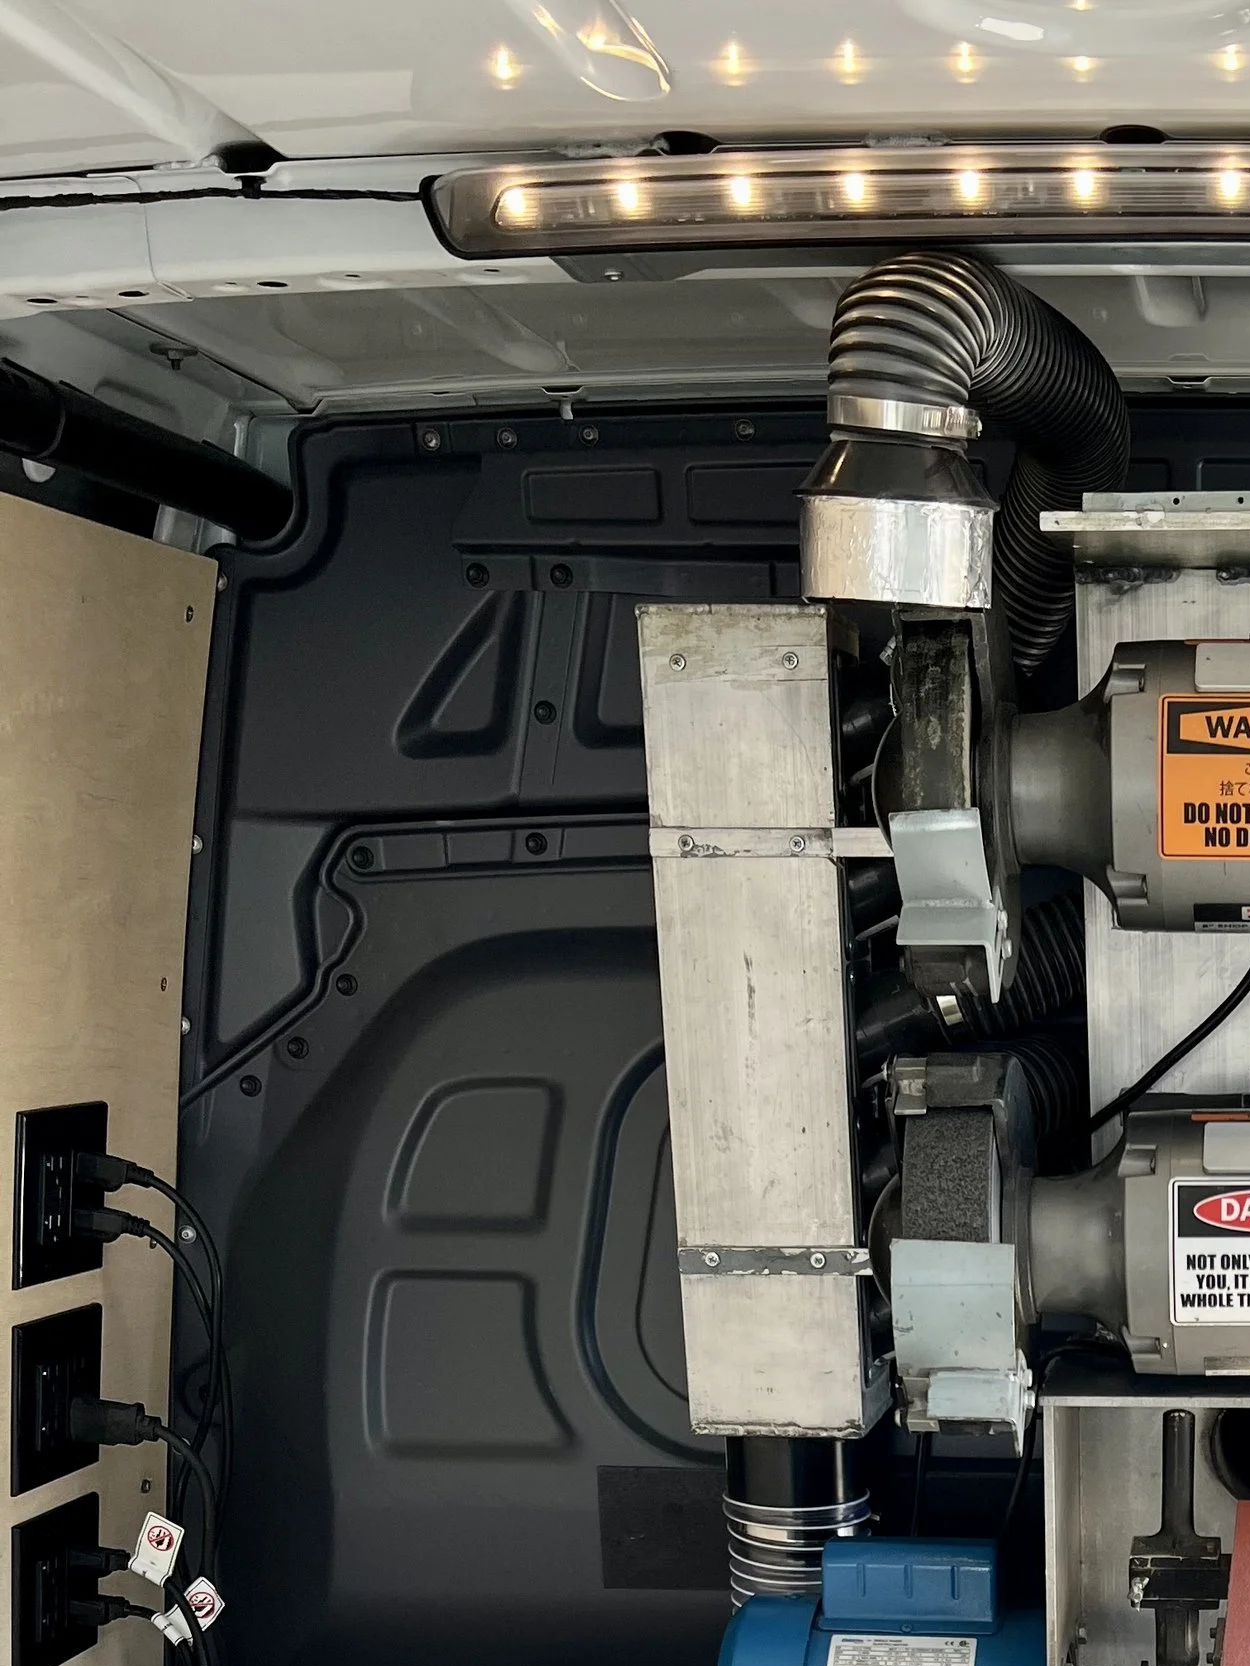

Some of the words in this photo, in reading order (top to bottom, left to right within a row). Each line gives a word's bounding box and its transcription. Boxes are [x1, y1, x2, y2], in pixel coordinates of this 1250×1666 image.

[1184, 802, 1210, 824] DO
[1204, 827, 1231, 847] NO
[1186, 1254, 1217, 1270] NOT
[1196, 1274, 1230, 1291] YOU,
[1234, 1274, 1249, 1289] IT
[1180, 1293, 1234, 1307] WHOLE
